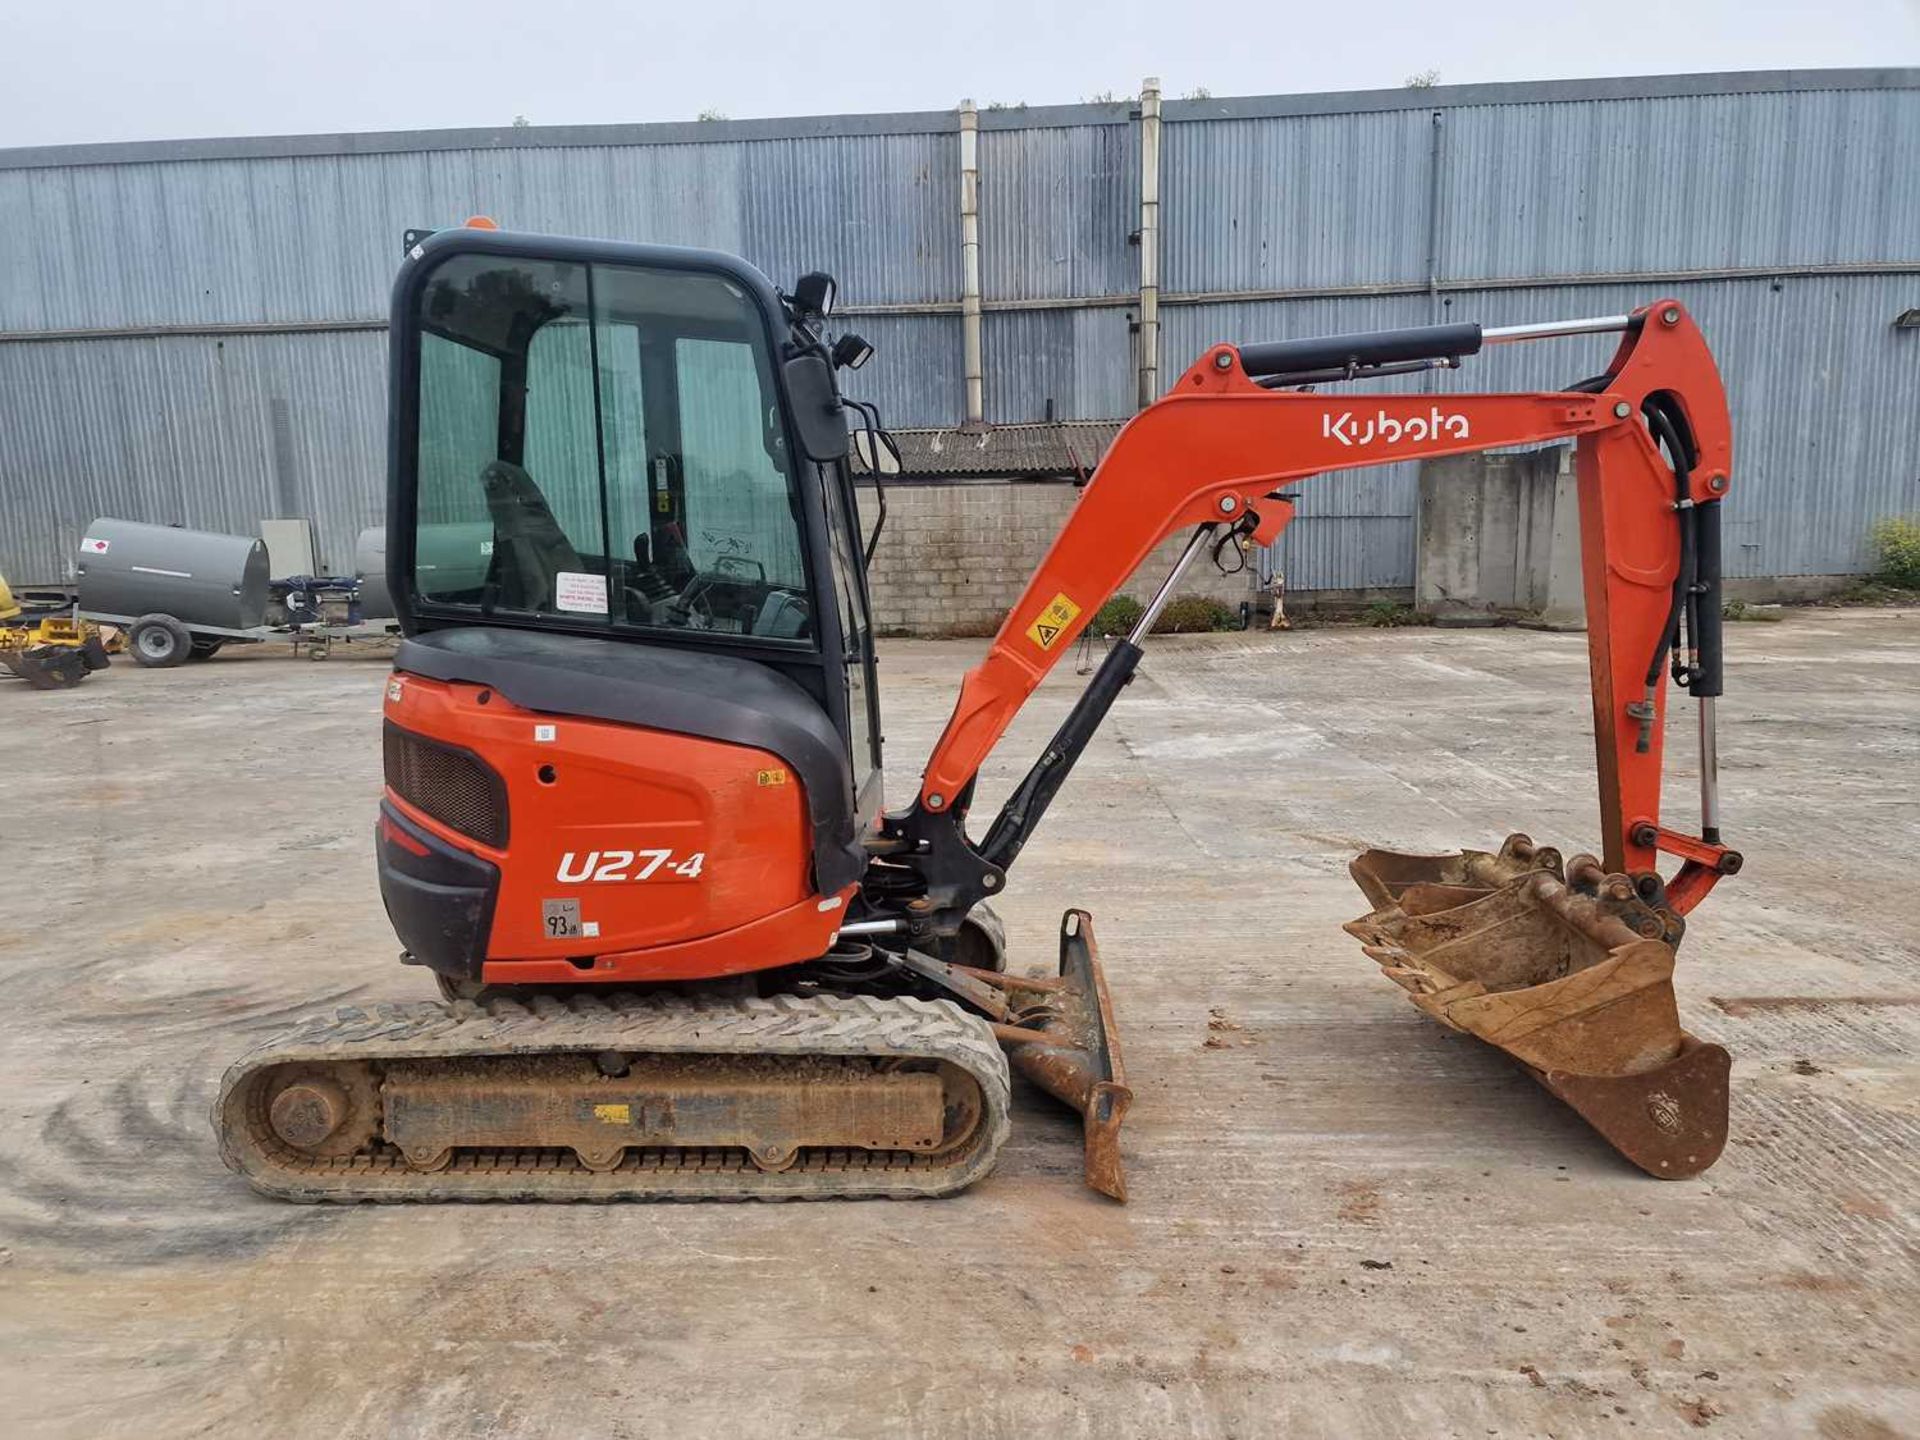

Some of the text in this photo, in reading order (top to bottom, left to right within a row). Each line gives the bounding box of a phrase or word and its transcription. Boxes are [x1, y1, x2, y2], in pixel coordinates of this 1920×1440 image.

[1323, 407, 1469, 446] Kubota
[556, 849, 705, 883] U27-4
[547, 916, 568, 935] 93
